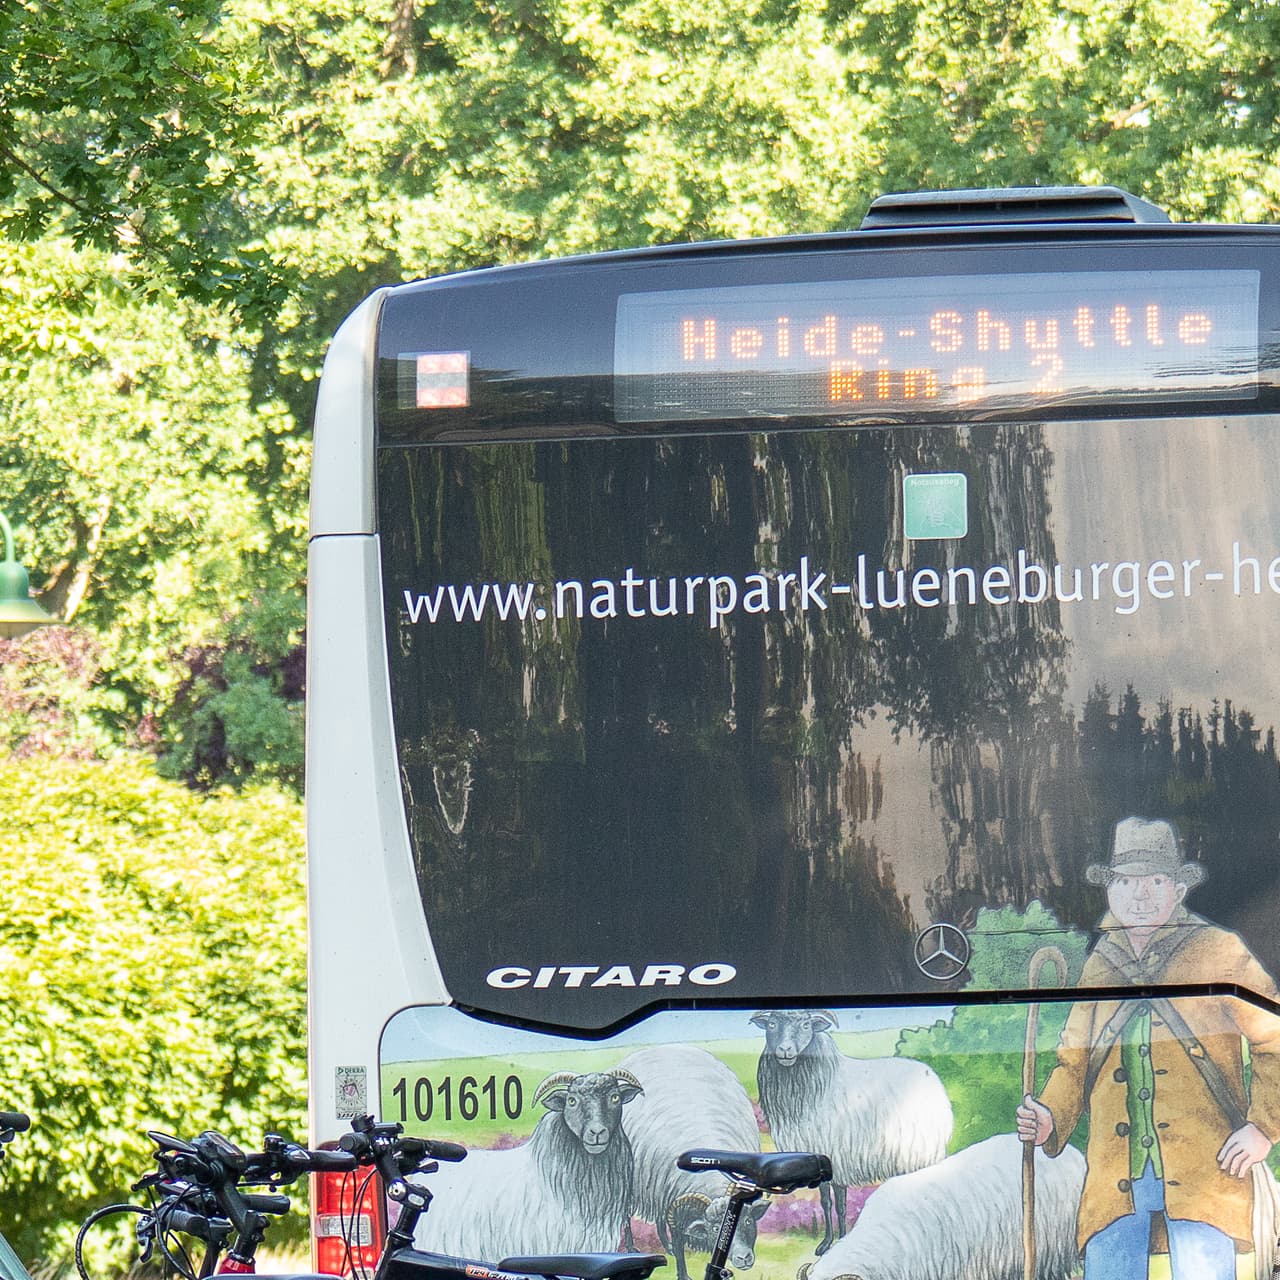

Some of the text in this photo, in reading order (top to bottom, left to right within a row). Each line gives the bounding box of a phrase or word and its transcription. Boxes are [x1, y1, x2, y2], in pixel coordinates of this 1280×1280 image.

[682, 304, 1214, 361] Heide-Shuttle
[1028, 353, 1065, 396] 2
[486, 962, 738, 990] CITARO
[392, 1075, 523, 1122] 101610
